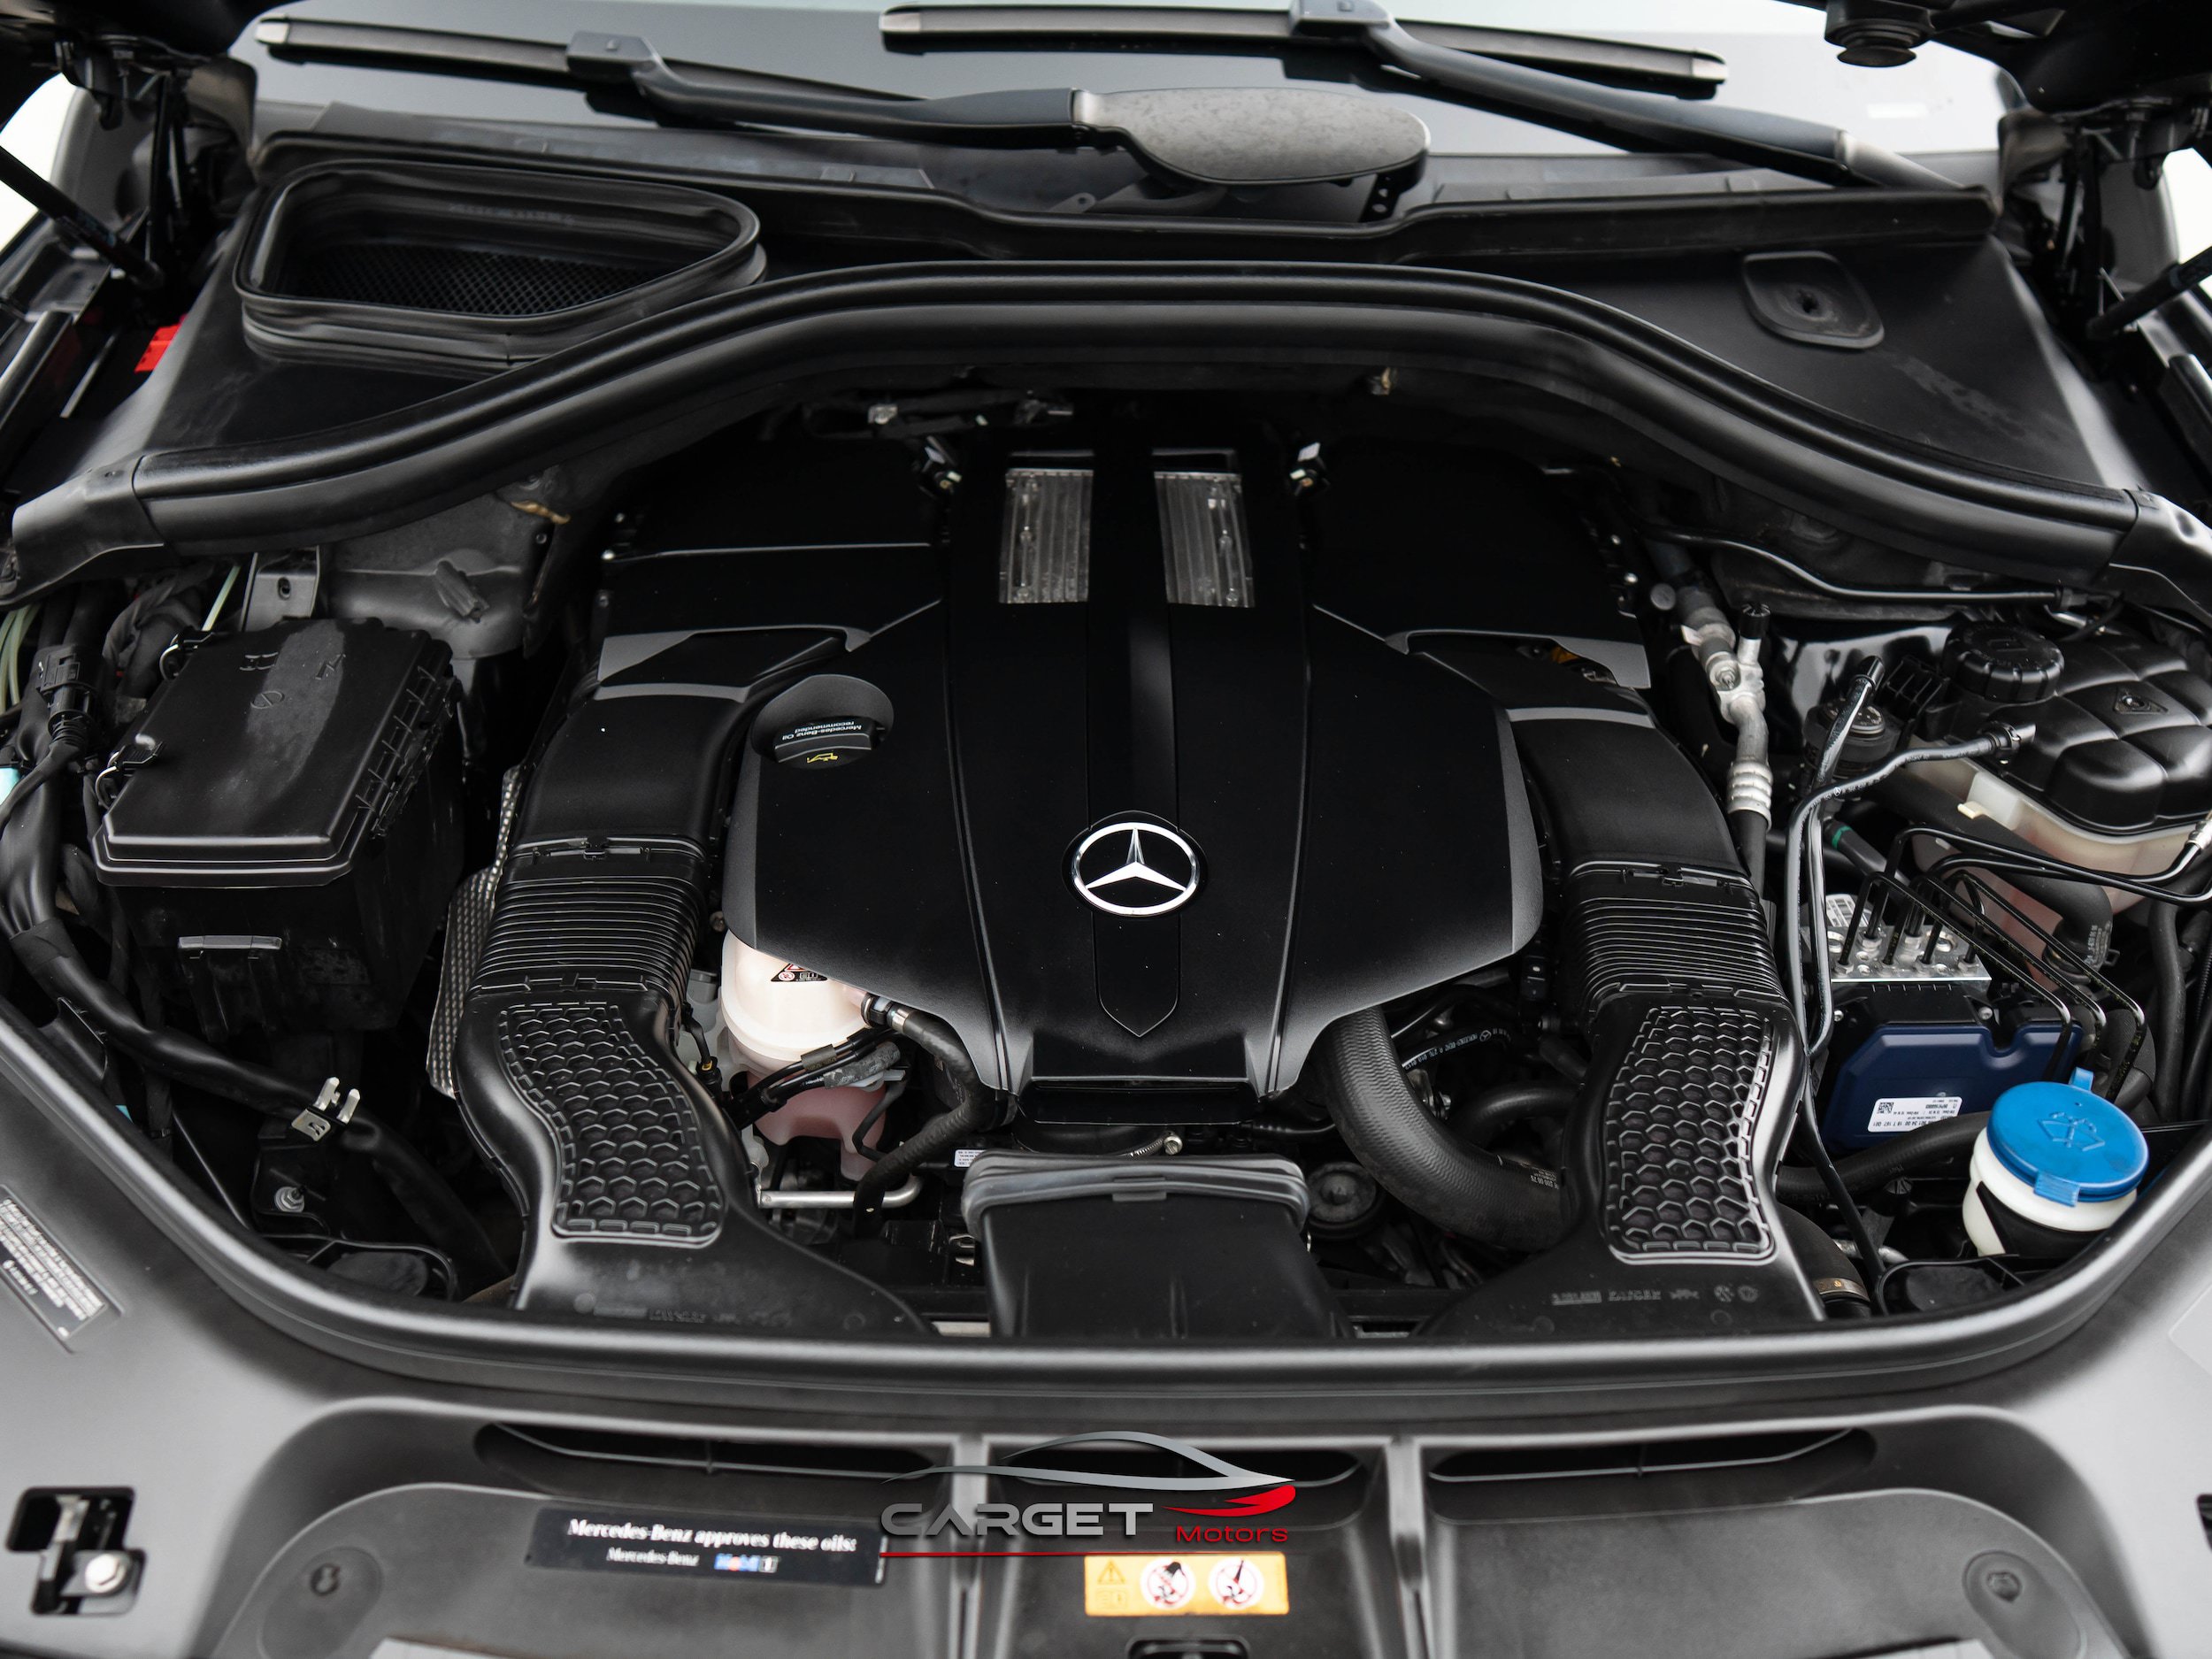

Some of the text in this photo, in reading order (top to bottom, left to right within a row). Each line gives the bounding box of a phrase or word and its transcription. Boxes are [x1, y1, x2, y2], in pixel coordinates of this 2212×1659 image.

[795, 721, 855, 733] recommended
[795, 725, 863, 737] Mercedes-Benz
[566, 1517, 693, 1544] Mercedes-Benz
[694, 1528, 770, 1548] approves
[772, 1532, 818, 1550] these
